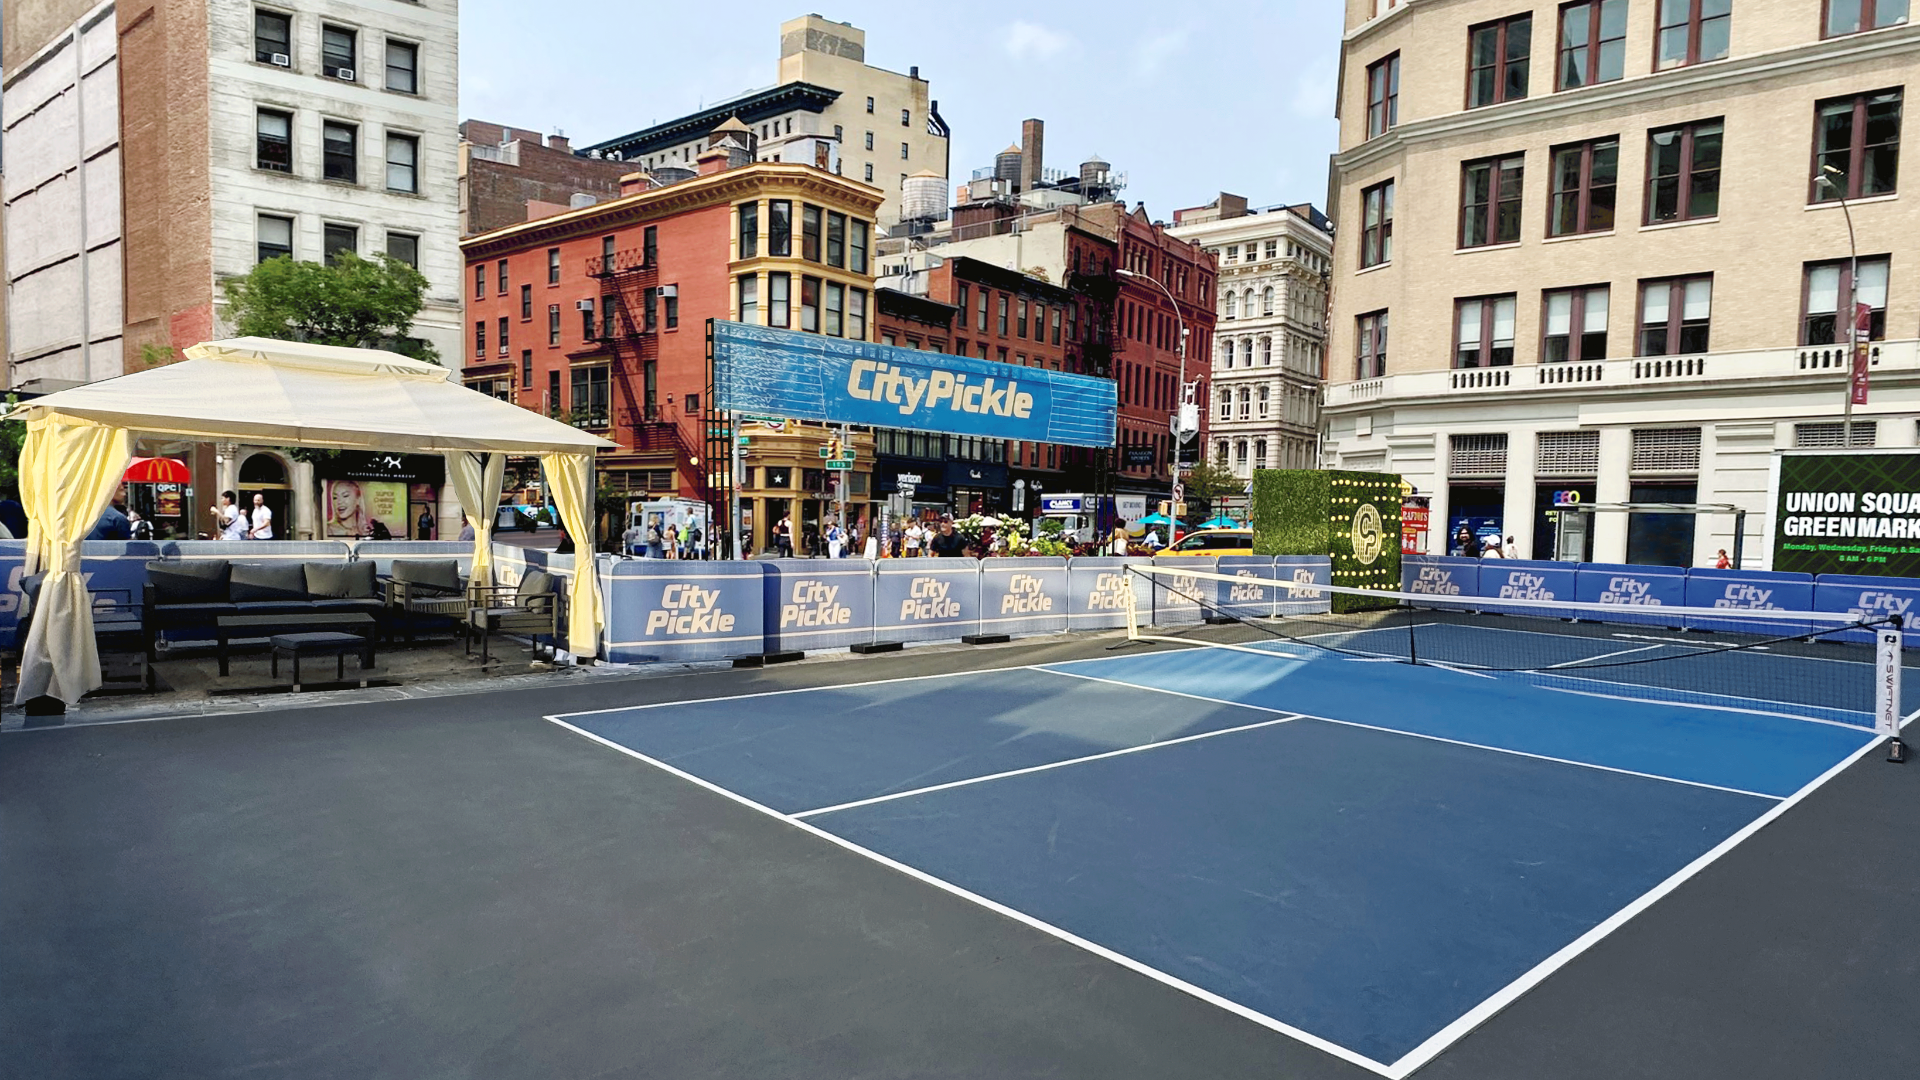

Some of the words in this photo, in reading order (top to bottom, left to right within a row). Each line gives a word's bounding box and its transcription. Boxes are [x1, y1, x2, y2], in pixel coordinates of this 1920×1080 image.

[848, 359, 1034, 419] CityPickle
[1786, 492, 1856, 512] UNION
[1783, 543, 1817, 551] Monday,
[1819, 544, 1868, 553] Wednesday,
[1870, 545, 1899, 554] Friday,
[1010, 574, 1043, 597] City
[1419, 567, 1451, 584] City
[1508, 572, 1544, 591] City
[661, 583, 721, 612] City
[792, 580, 839, 606] City
[910, 577, 950, 602] City
[1230, 585, 1264, 601] Pickle
[1410, 580, 1460, 595] Pickle
[1500, 585, 1554, 600] Pickle
[1609, 577, 1650, 597] City
[1724, 584, 1773, 605] City
[900, 598, 961, 621] Pickle
[1001, 593, 1052, 614] Pickle
[1858, 591, 1914, 614] City
[645, 608, 735, 635] Pickle
[781, 603, 851, 628] Pickle
[1885, 665, 1894, 729] SWIFTNET
